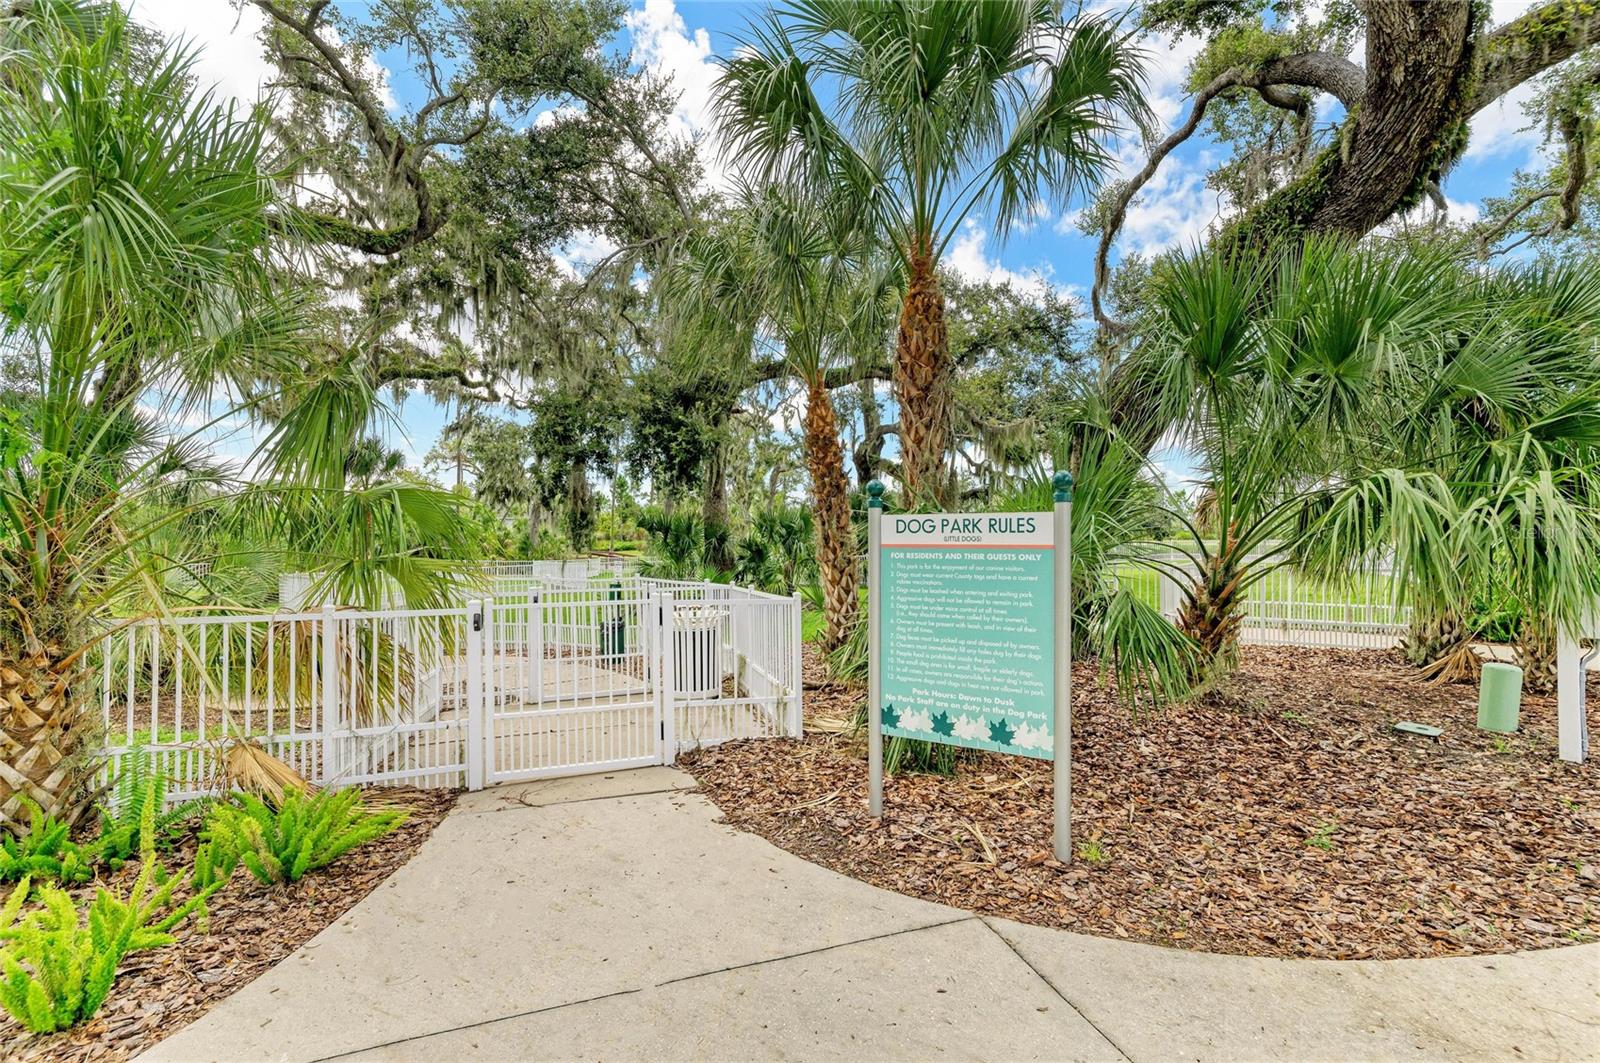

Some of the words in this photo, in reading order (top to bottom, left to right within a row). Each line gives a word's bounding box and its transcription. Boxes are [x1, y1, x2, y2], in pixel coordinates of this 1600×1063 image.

[896, 519, 936, 534] DOG
[941, 518, 982, 533] PARK
[988, 518, 1036, 533] RULES
[906, 552, 943, 560] RESIDENTS
[954, 573, 972, 581] County
[1006, 616, 1027, 624] owners).
[967, 622, 983, 630] leash,
[928, 644, 958, 652] immediately
[896, 649, 912, 657] People
[953, 672, 983, 680] responsible
[999, 668, 1018, 676] elderly
[1019, 670, 1033, 678] dogs.
[947, 680, 960, 688] dogs
[1000, 686, 1022, 694] allowed
[912, 688, 929, 696] Park
[932, 690, 956, 699] Hours:
[959, 693, 981, 703] Dawn
[994, 698, 1015, 706] Dusk
[898, 695, 915, 703] Park
[917, 697, 934, 705] Staff
[963, 703, 980, 712] duty
[992, 707, 1005, 715] the
[1008, 709, 1024, 719] Dog
[1027, 711, 1048, 720] Park
